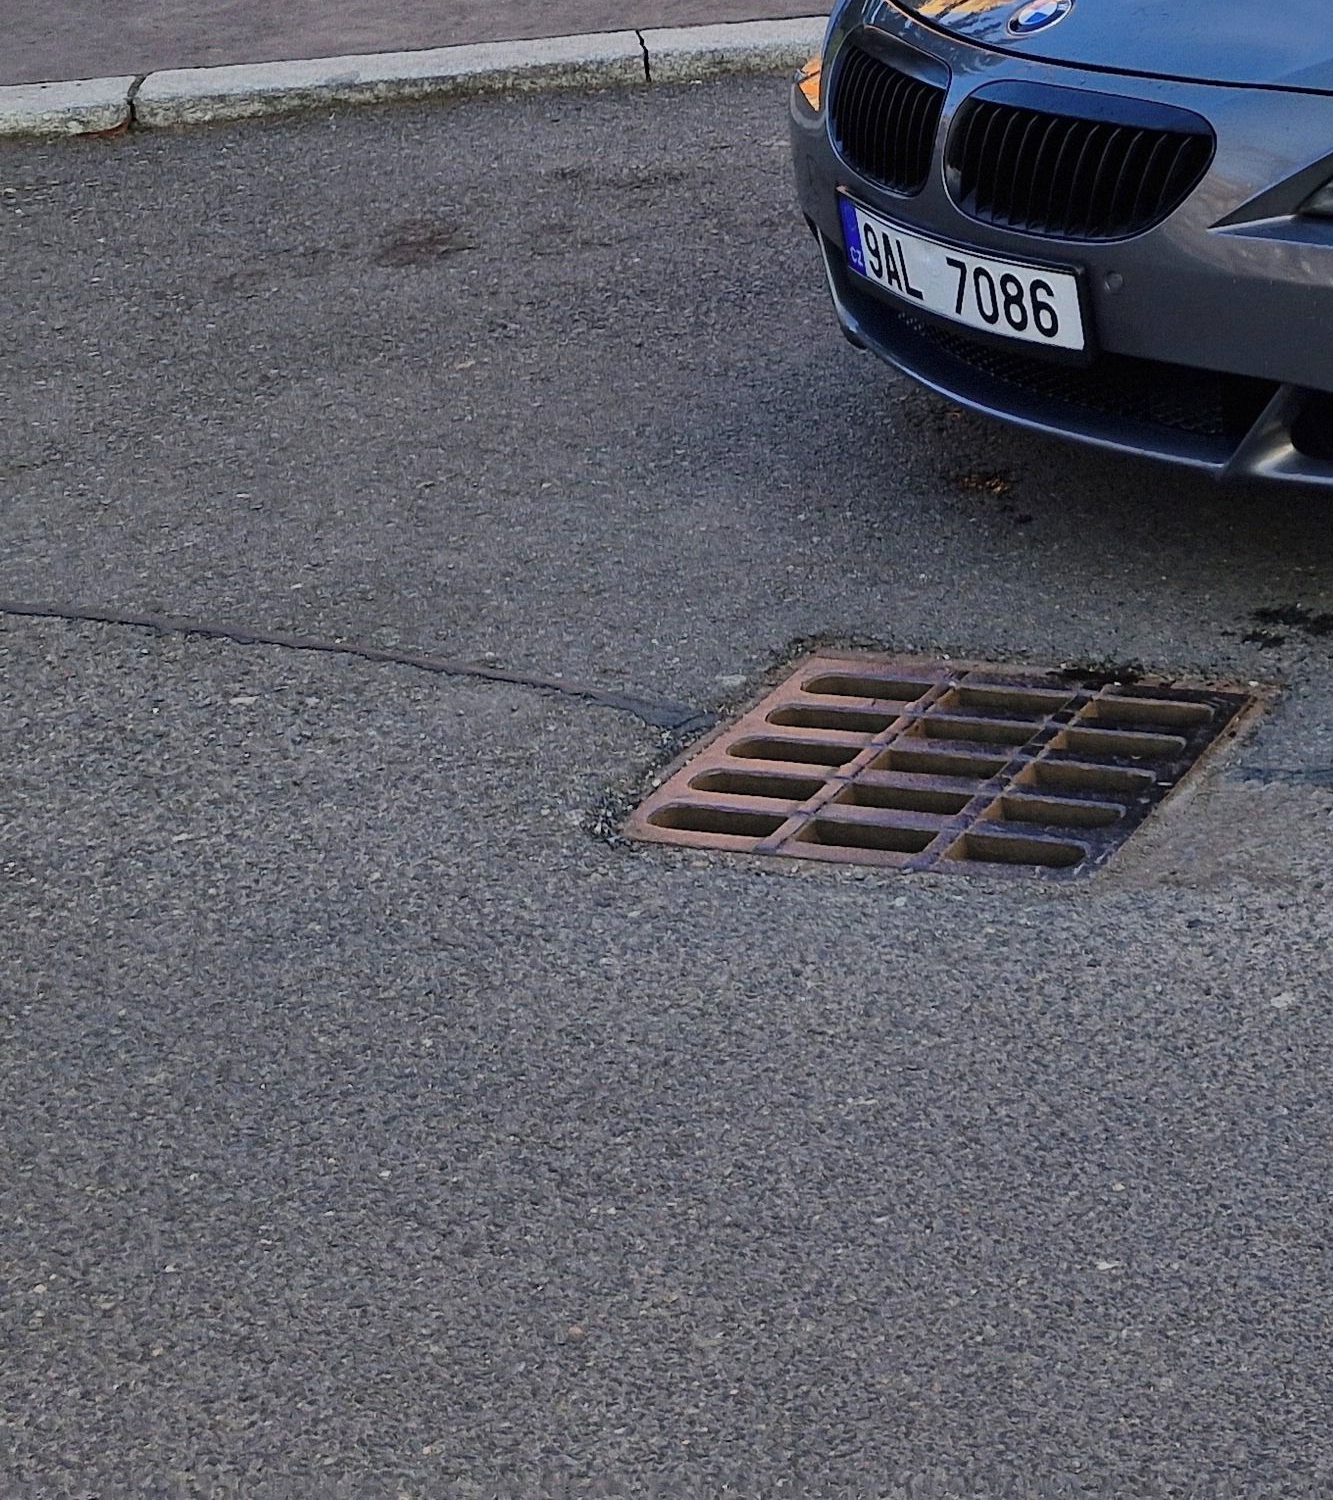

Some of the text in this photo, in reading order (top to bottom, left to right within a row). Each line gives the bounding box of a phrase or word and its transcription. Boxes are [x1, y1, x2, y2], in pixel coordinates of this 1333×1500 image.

[850, 246, 864, 267] CZ
[863, 222, 1059, 338] 9AL 7086
